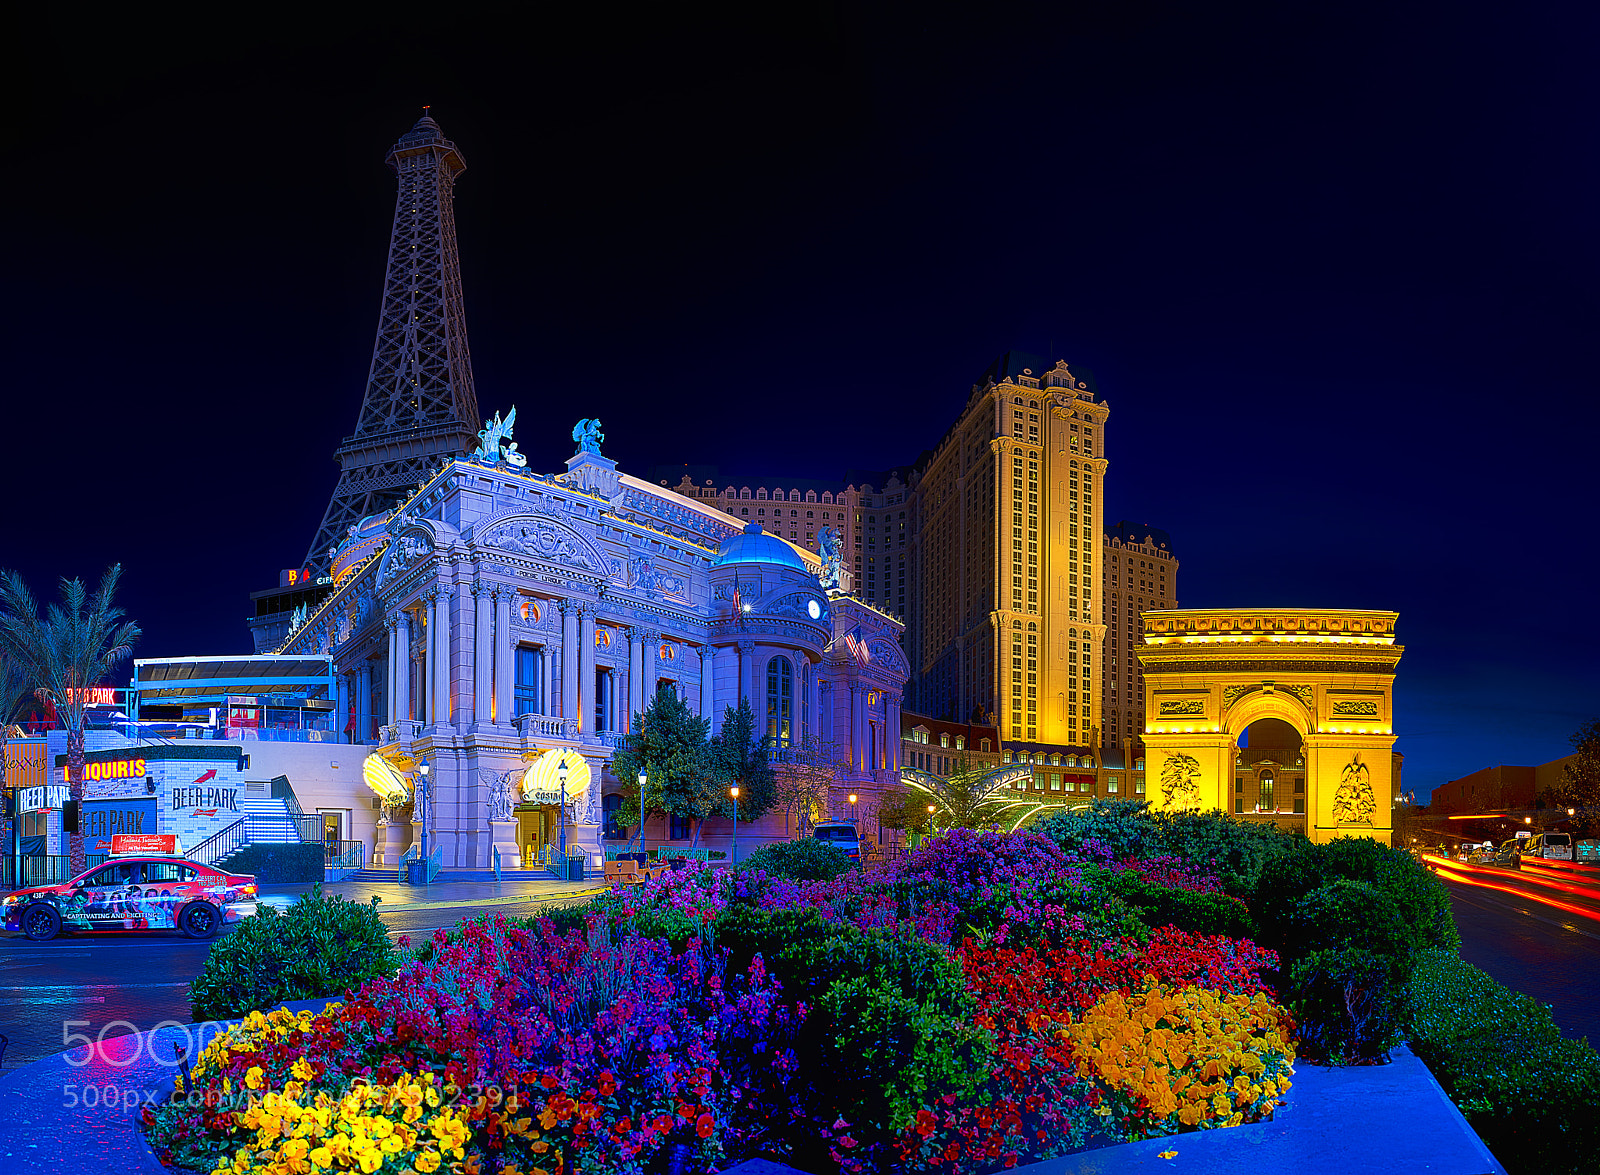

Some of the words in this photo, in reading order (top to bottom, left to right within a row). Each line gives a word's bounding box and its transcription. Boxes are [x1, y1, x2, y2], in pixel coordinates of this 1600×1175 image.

[91, 688, 115, 706] PARK
[64, 758, 146, 782] IQUIRIS
[20, 786, 44, 812] BEER
[172, 787, 203, 811] BEER
[207, 787, 238, 812] PARK
[82, 811, 106, 839] EER
[109, 809, 145, 835] PARK
